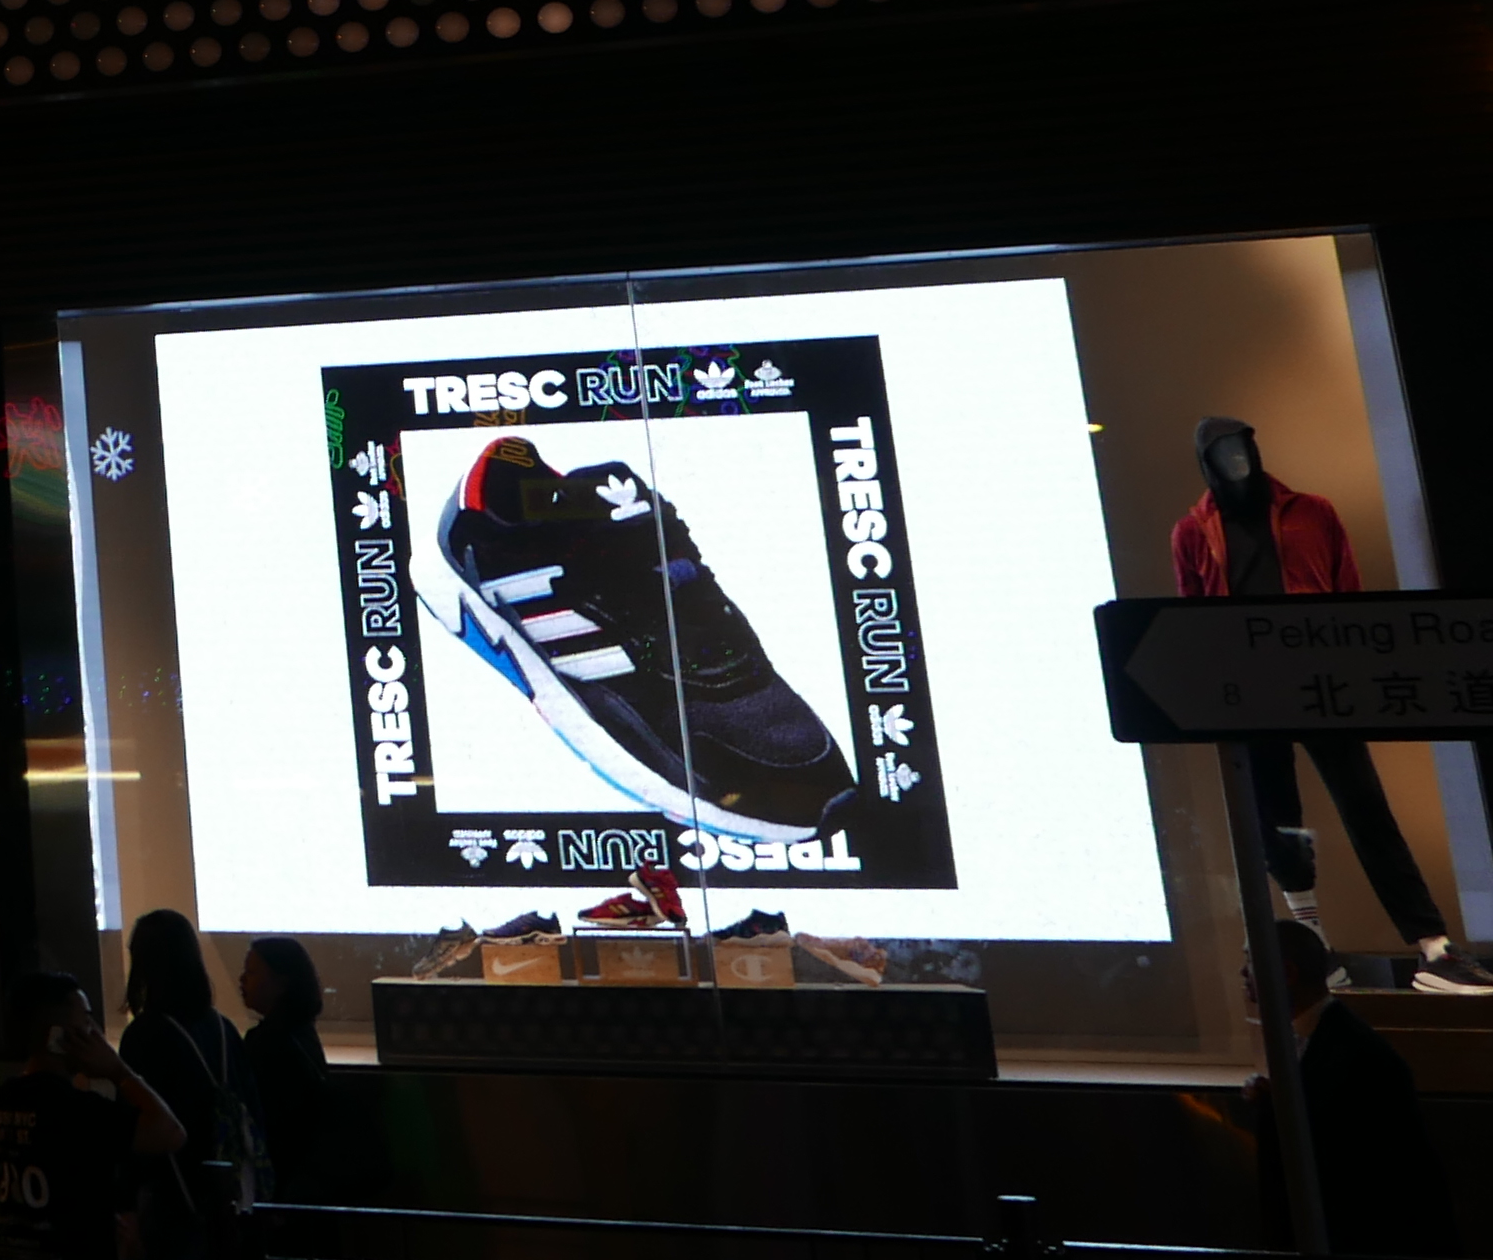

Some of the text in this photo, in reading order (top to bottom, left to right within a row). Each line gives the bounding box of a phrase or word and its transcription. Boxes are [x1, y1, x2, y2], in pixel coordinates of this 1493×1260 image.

[402, 369, 568, 415] TRESC
[576, 363, 685, 407] RUN
[830, 416, 893, 581] TRESC
[356, 539, 402, 636] RUN
[1245, 616, 1395, 654] Peking
[853, 588, 911, 694] RUN
[365, 645, 417, 805] TRESC
[1223, 669, 1493, 718] 8 北京道
